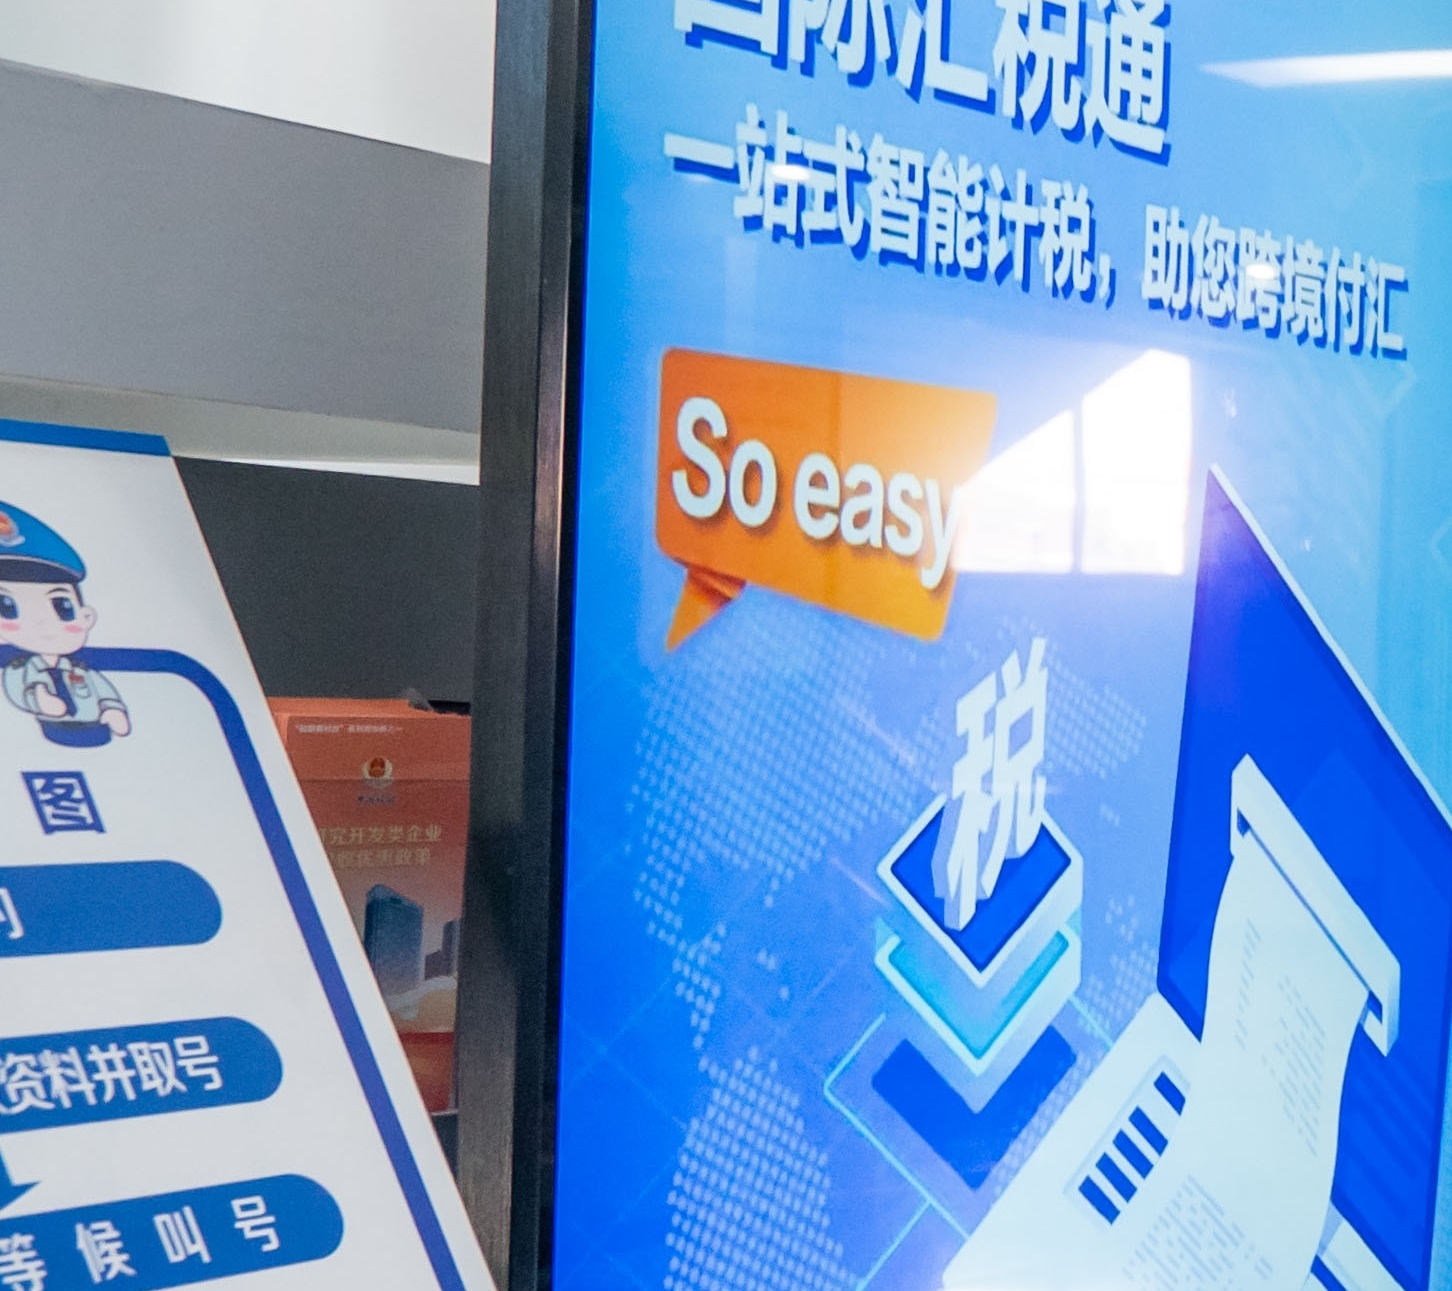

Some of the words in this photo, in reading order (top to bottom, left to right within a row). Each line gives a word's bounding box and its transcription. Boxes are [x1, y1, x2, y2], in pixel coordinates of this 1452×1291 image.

[661, 105, 1408, 353] 一站式智能计税，助您跨境付汇
[671, 395, 778, 530] So
[793, 458, 965, 590] easy
[20, 770, 107, 835] 图
[944, 637, 1048, 931] 税
[0, 1034, 224, 1116] 资料并取号
